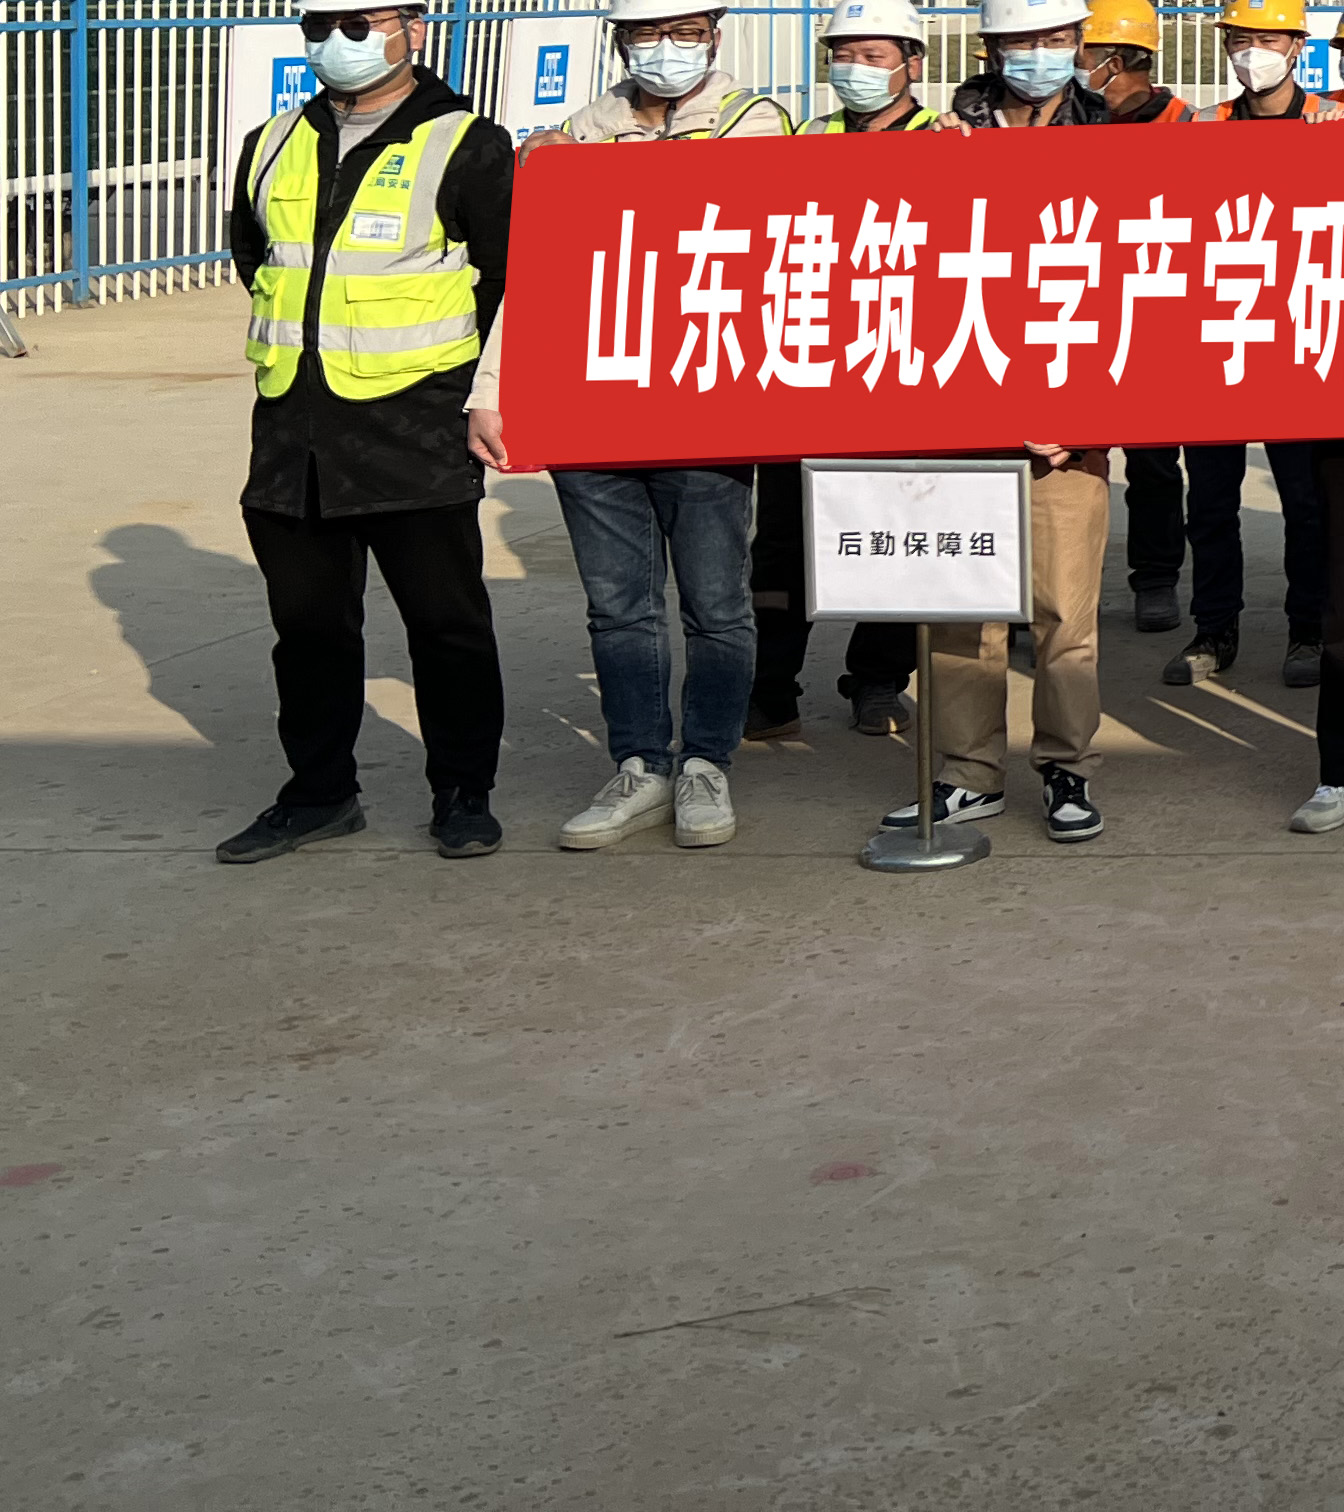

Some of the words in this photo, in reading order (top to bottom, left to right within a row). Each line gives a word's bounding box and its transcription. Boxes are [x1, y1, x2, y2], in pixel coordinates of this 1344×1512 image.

[837, 530, 996, 557] 后勤保障组
